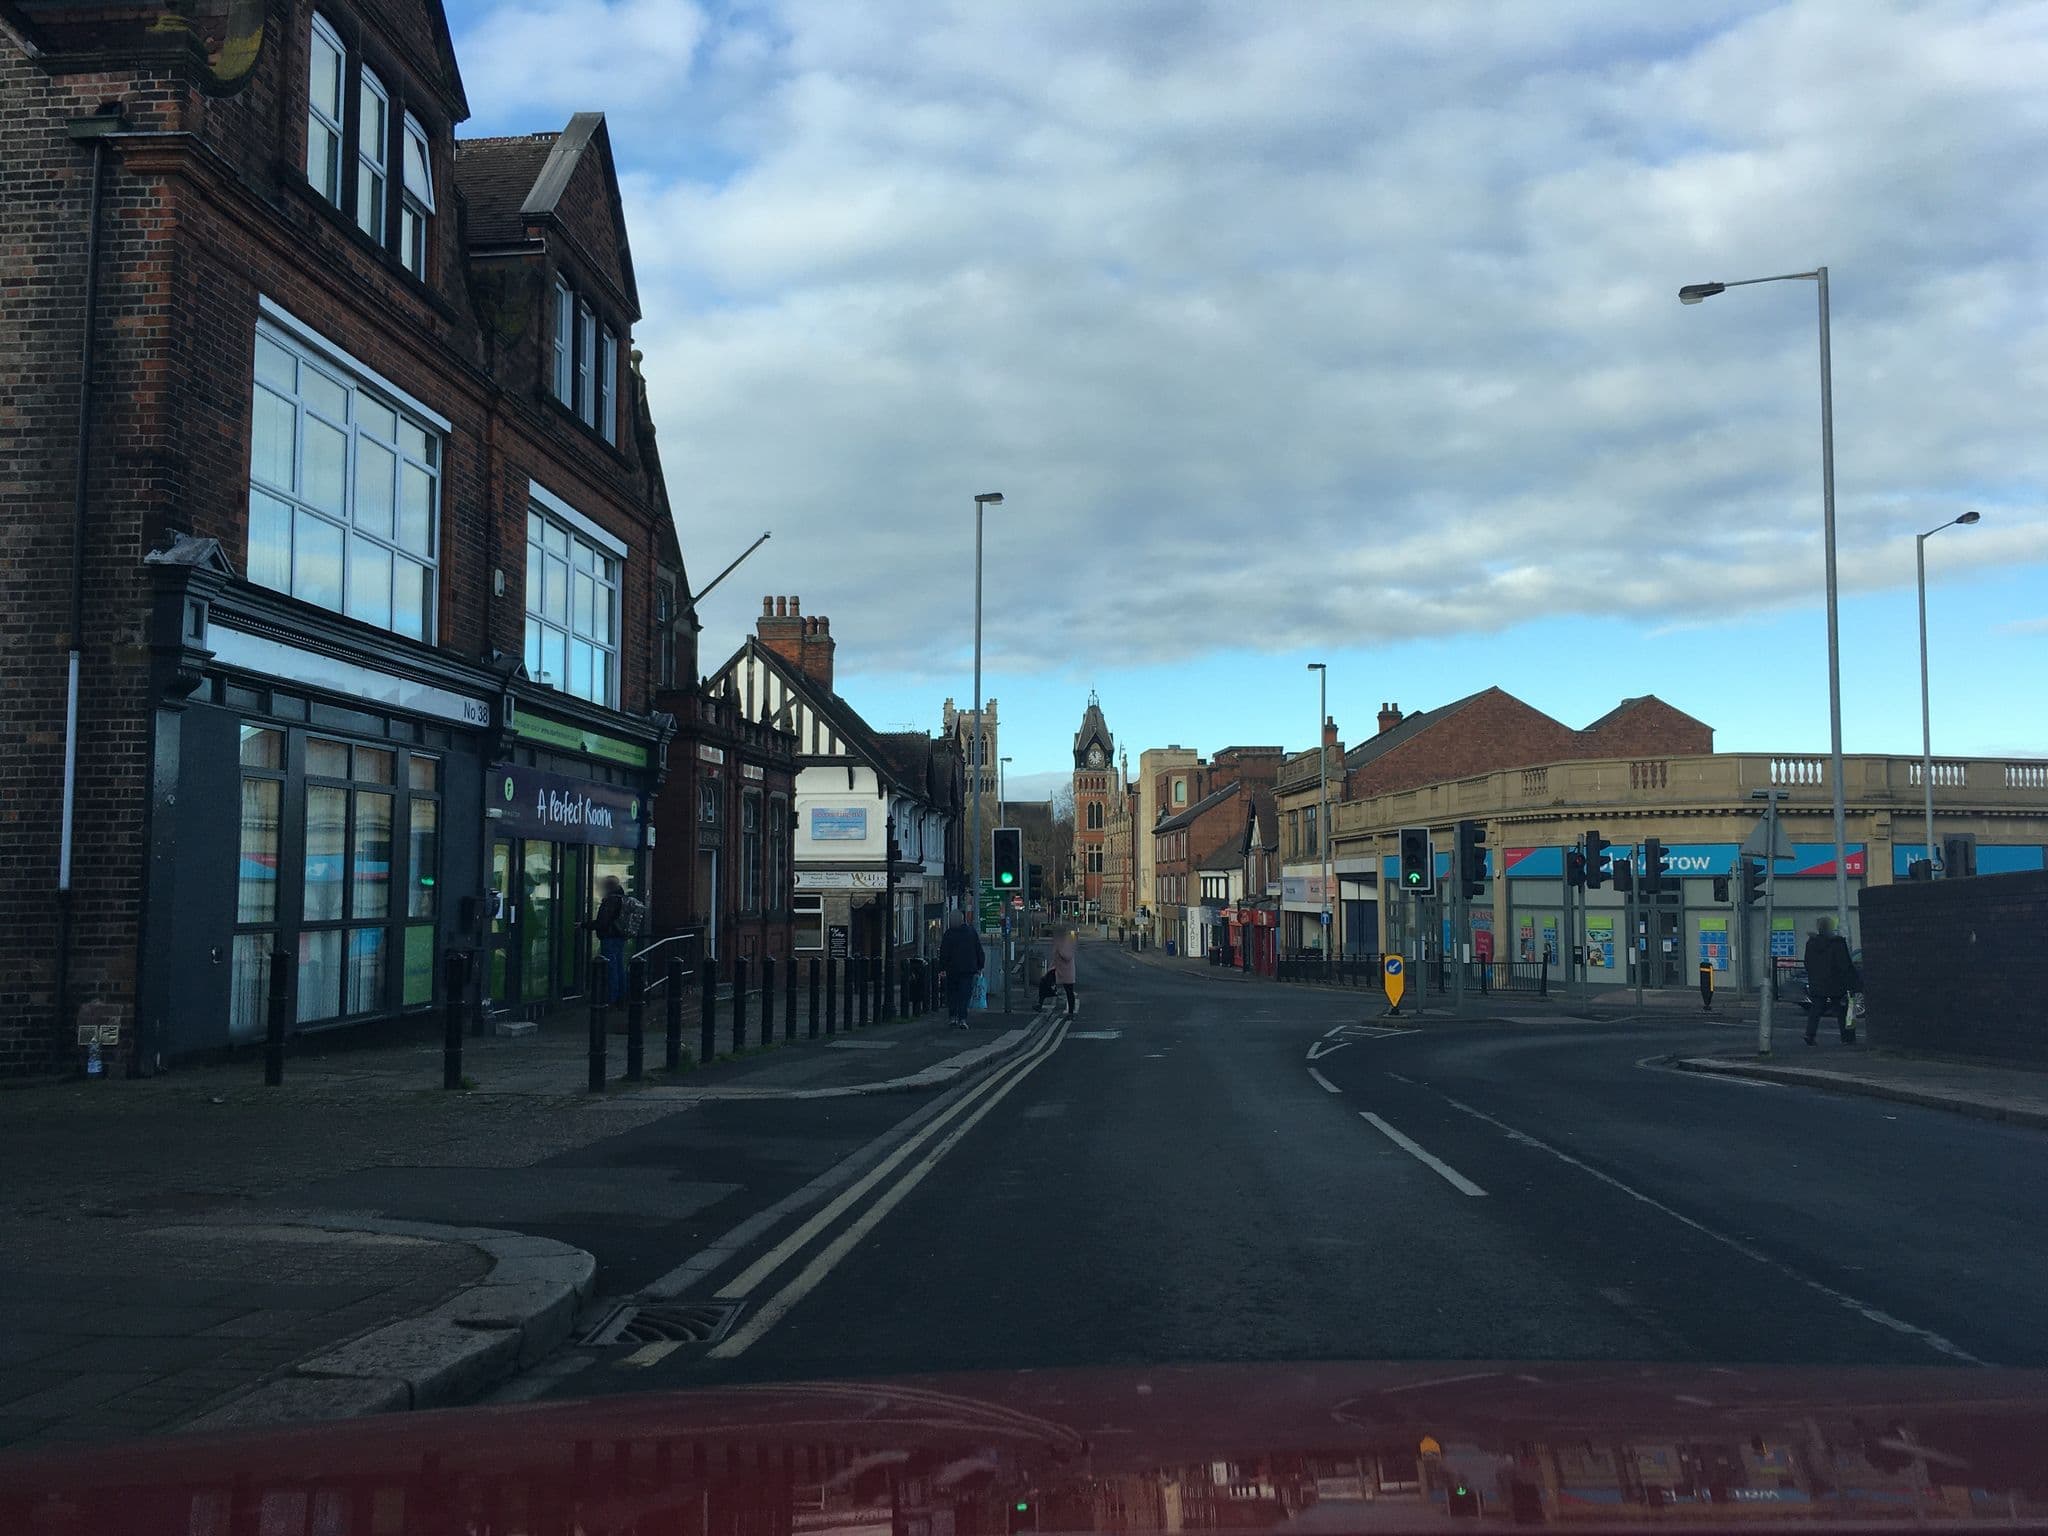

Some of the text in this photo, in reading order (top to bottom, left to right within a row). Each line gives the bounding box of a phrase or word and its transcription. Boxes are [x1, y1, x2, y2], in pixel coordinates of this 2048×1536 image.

[463, 701, 489, 724] No 38
[537, 788, 547, 826] A
[549, 789, 583, 826] Perfect
[585, 797, 613, 829] Room
